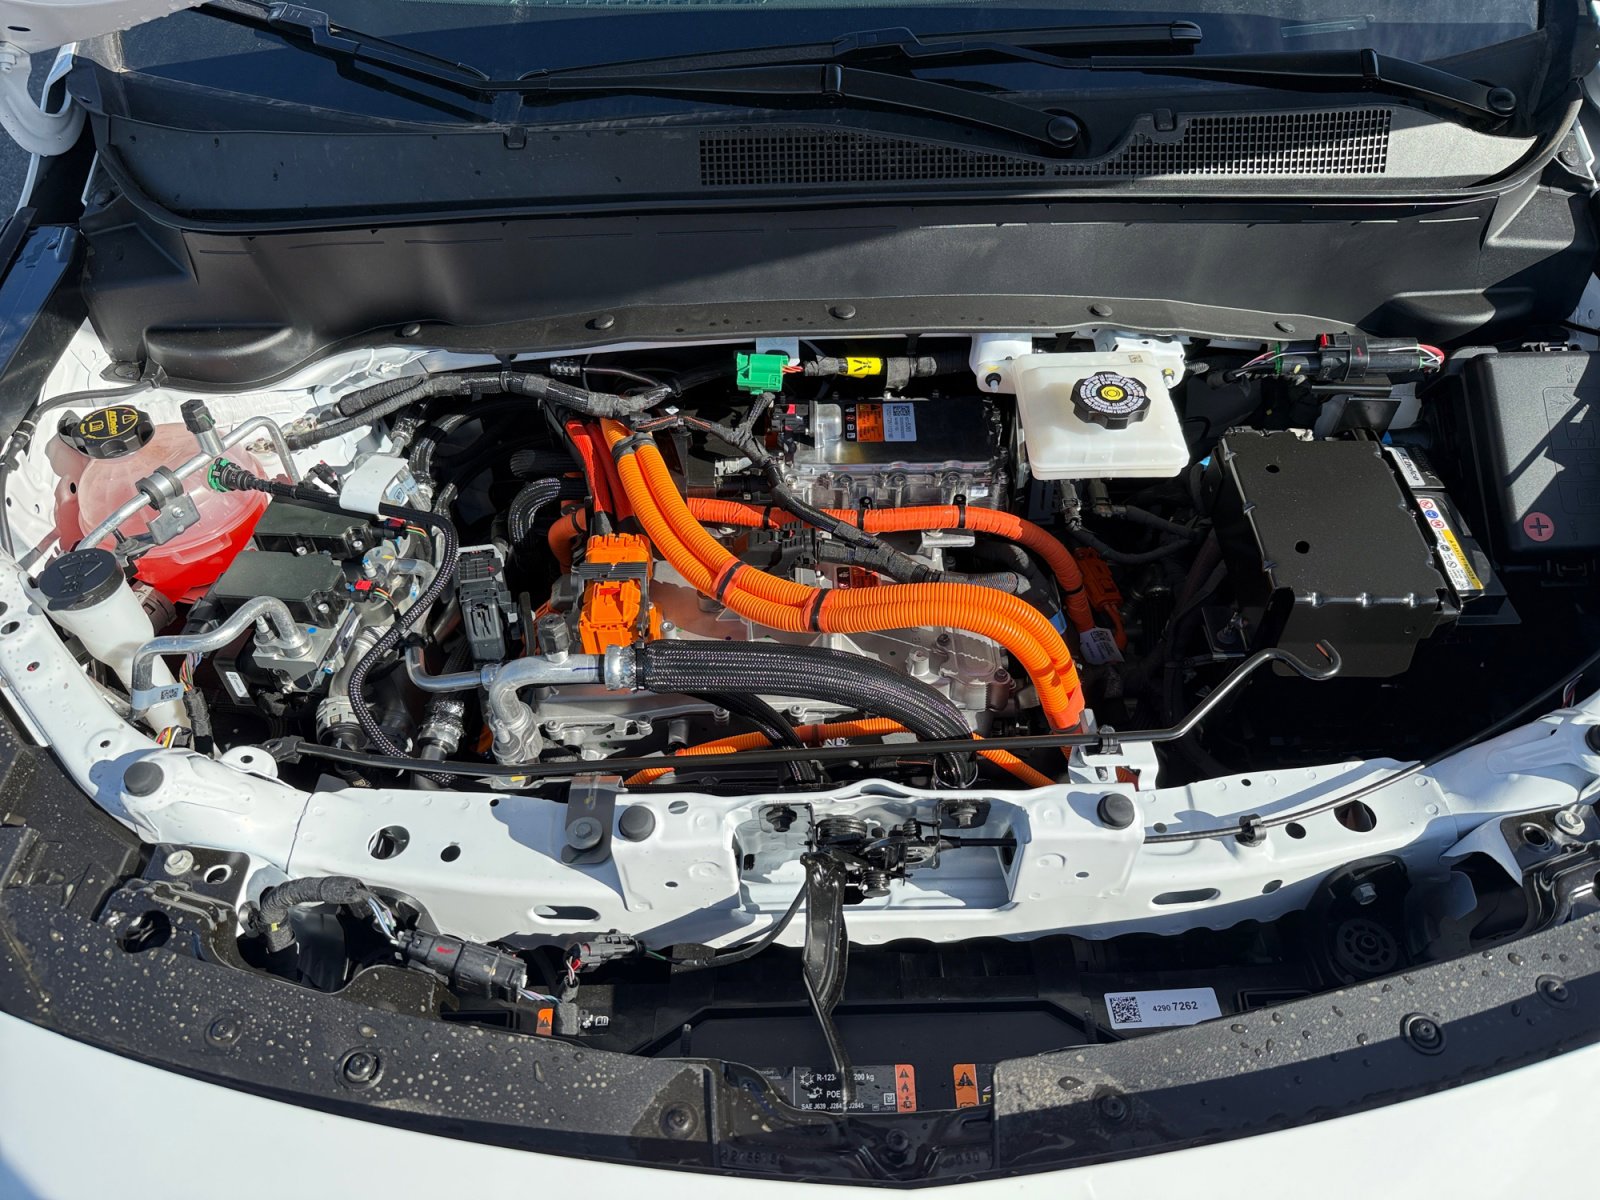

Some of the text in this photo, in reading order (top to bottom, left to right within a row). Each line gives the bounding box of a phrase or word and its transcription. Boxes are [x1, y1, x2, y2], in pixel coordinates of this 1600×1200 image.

[816, 1073, 837, 1081] R-123
[866, 1073, 875, 1082] kg
[826, 1090, 841, 1098] POE
[829, 1102, 842, 1110] J284
